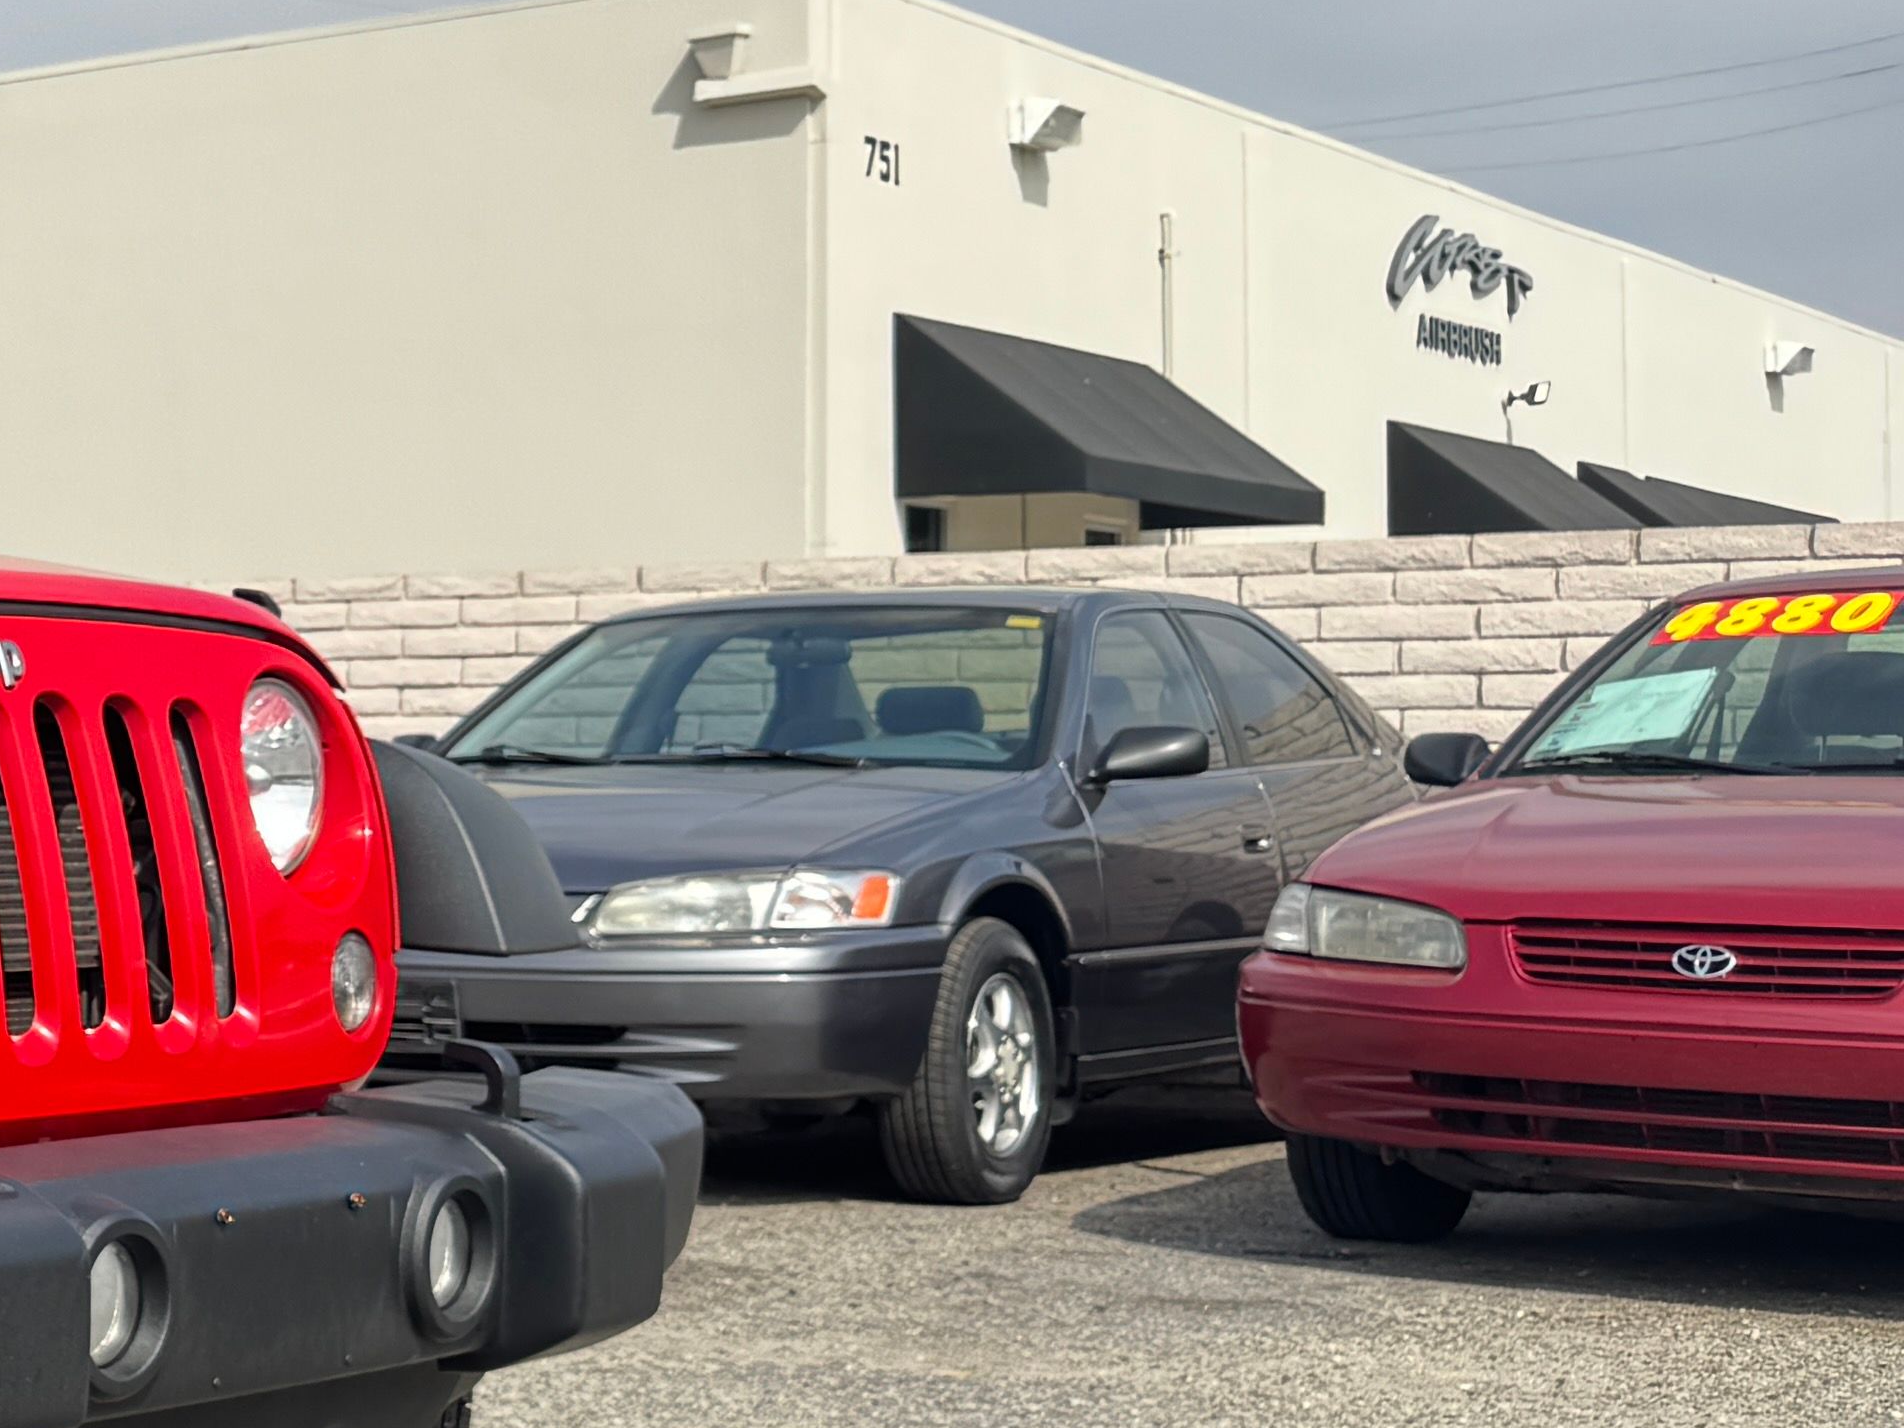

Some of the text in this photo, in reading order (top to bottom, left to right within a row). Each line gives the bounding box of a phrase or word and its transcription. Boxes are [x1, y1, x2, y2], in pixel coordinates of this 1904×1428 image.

[863, 135, 900, 187] 751
[1417, 313, 1502, 367] AIRBRUSH
[1664, 592, 1895, 642] 4880
